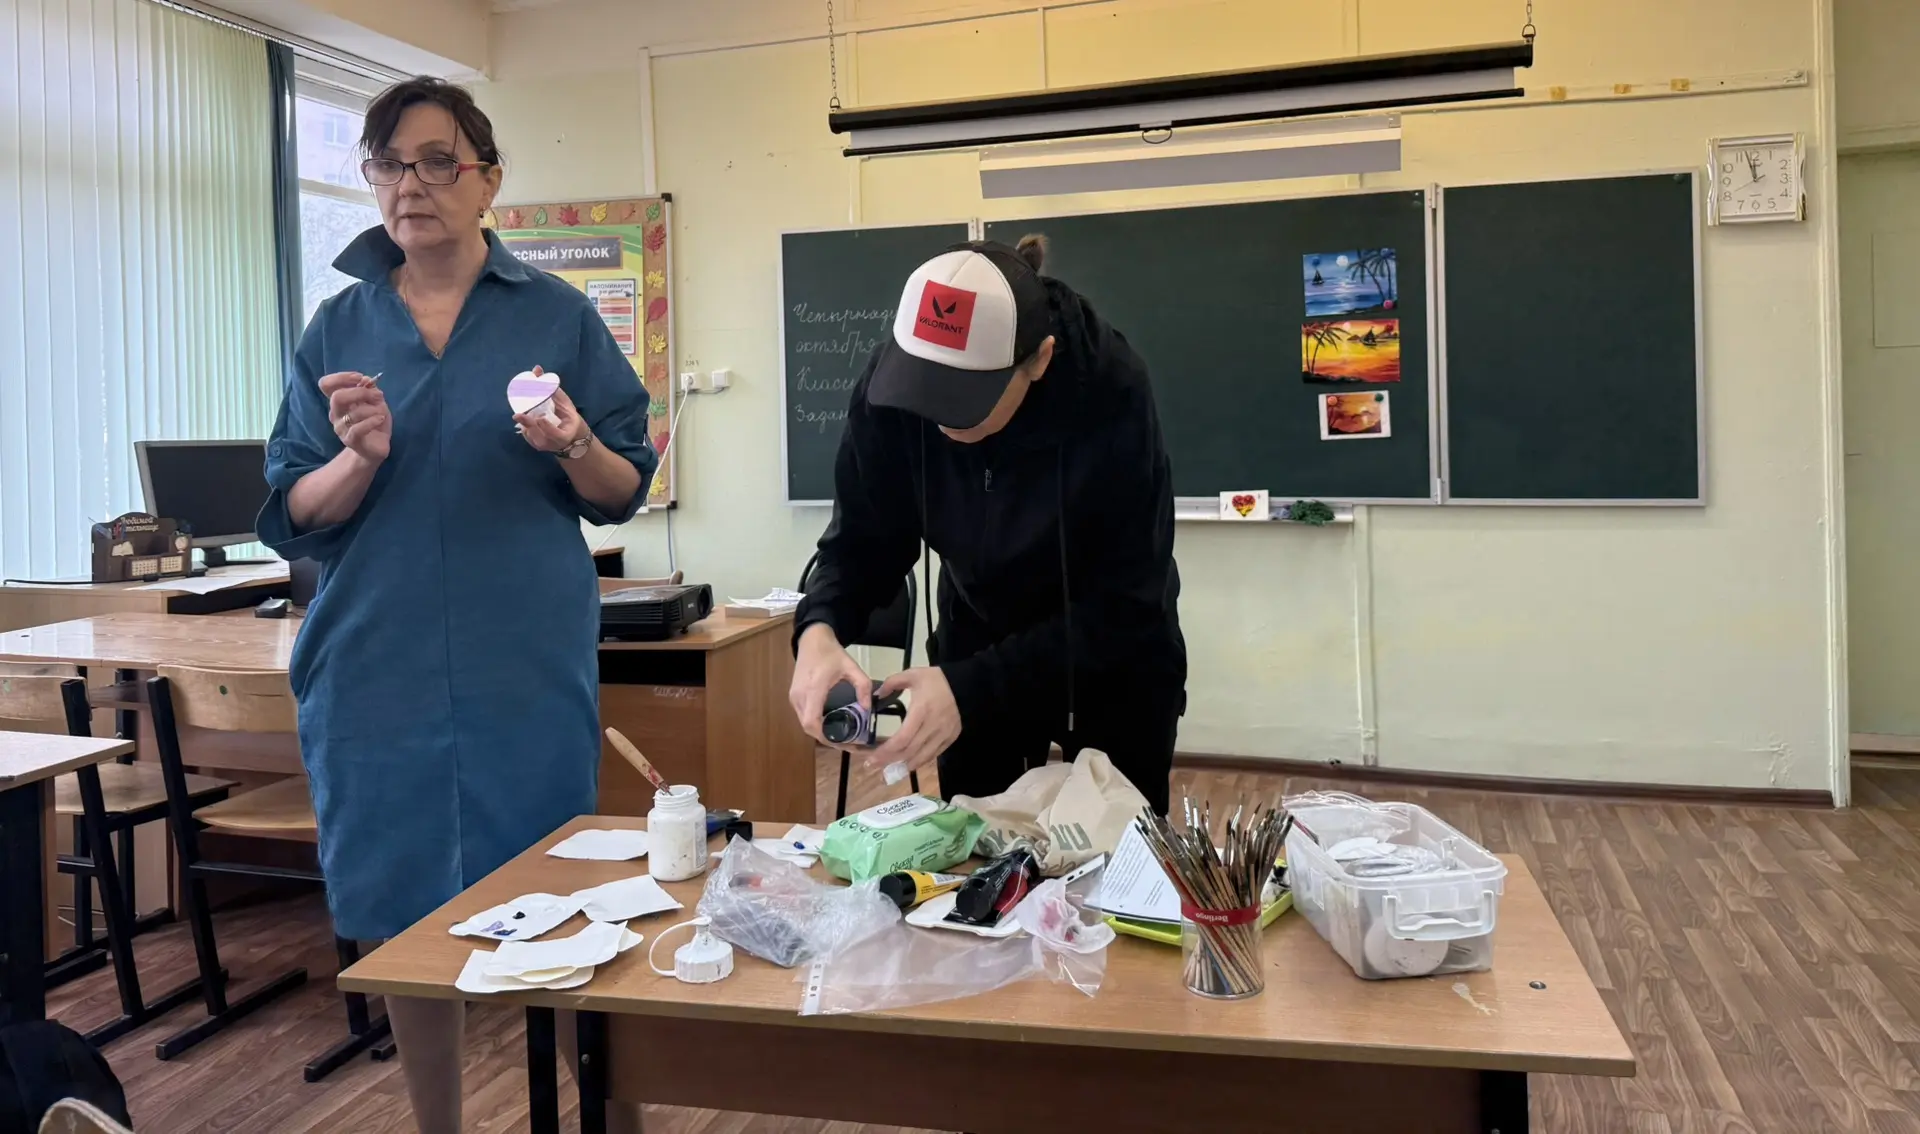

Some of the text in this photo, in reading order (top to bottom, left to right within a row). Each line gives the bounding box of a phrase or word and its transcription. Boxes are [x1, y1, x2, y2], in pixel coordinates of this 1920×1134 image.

[1722, 163, 1733, 174] 10
[1779, 159, 1788, 170] 2
[1722, 177, 1731, 187] 9
[1779, 174, 1789, 184] 3
[1723, 191, 1732, 201] 8
[1779, 188, 1788, 198] 4
[1737, 200, 1744, 210] 7
[1767, 198, 1777, 209] 5
[560, 247, 610, 260] УГОЛОК
[919, 316, 964, 335] VALORANT
[1195, 912, 1229, 923] Berlingo
